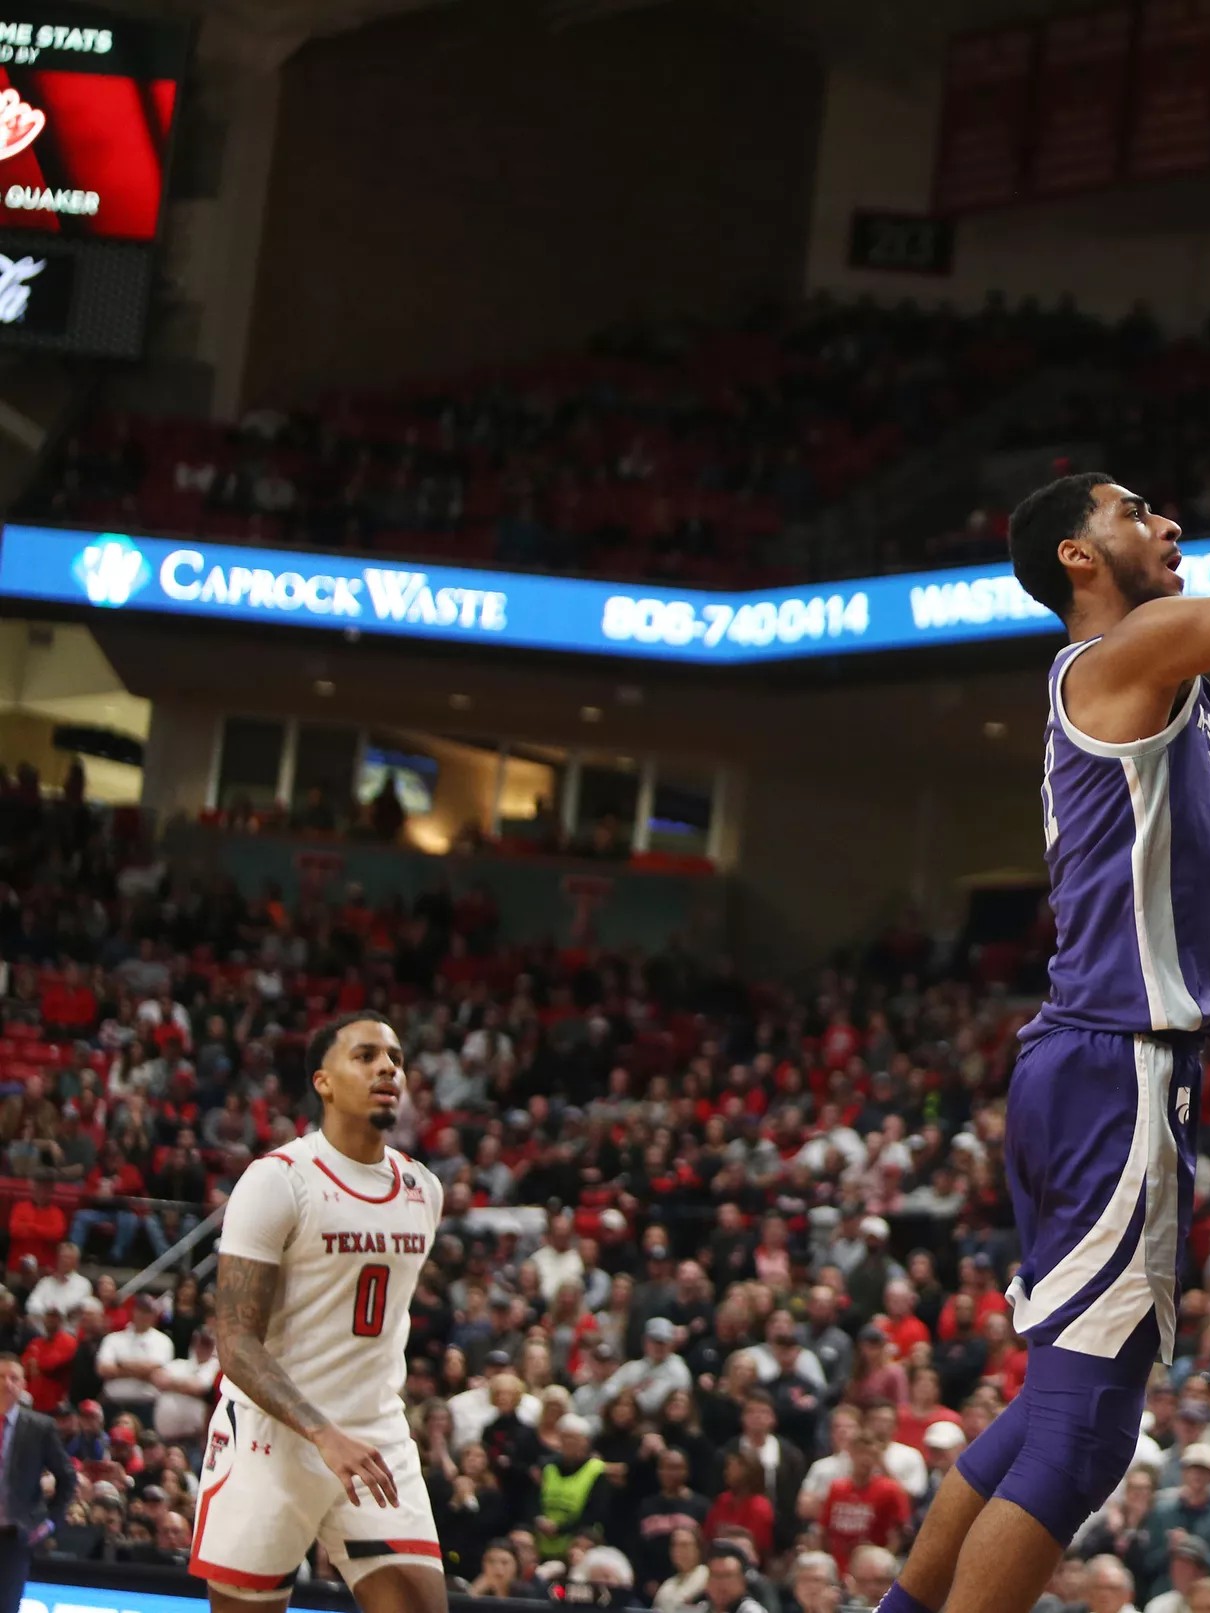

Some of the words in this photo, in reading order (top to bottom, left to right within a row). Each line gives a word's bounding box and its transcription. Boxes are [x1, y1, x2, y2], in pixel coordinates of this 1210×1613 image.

[35, 25, 112, 54] STATS
[15, 46, 40, 65] BY
[5, 185, 100, 215] QUAKER
[159, 548, 362, 618] CAPROCK
[363, 567, 509, 631] WASTE
[322, 1232, 386, 1254] TEXAS
[391, 1232, 426, 1254] TECH
[353, 1263, 390, 1337] 0
